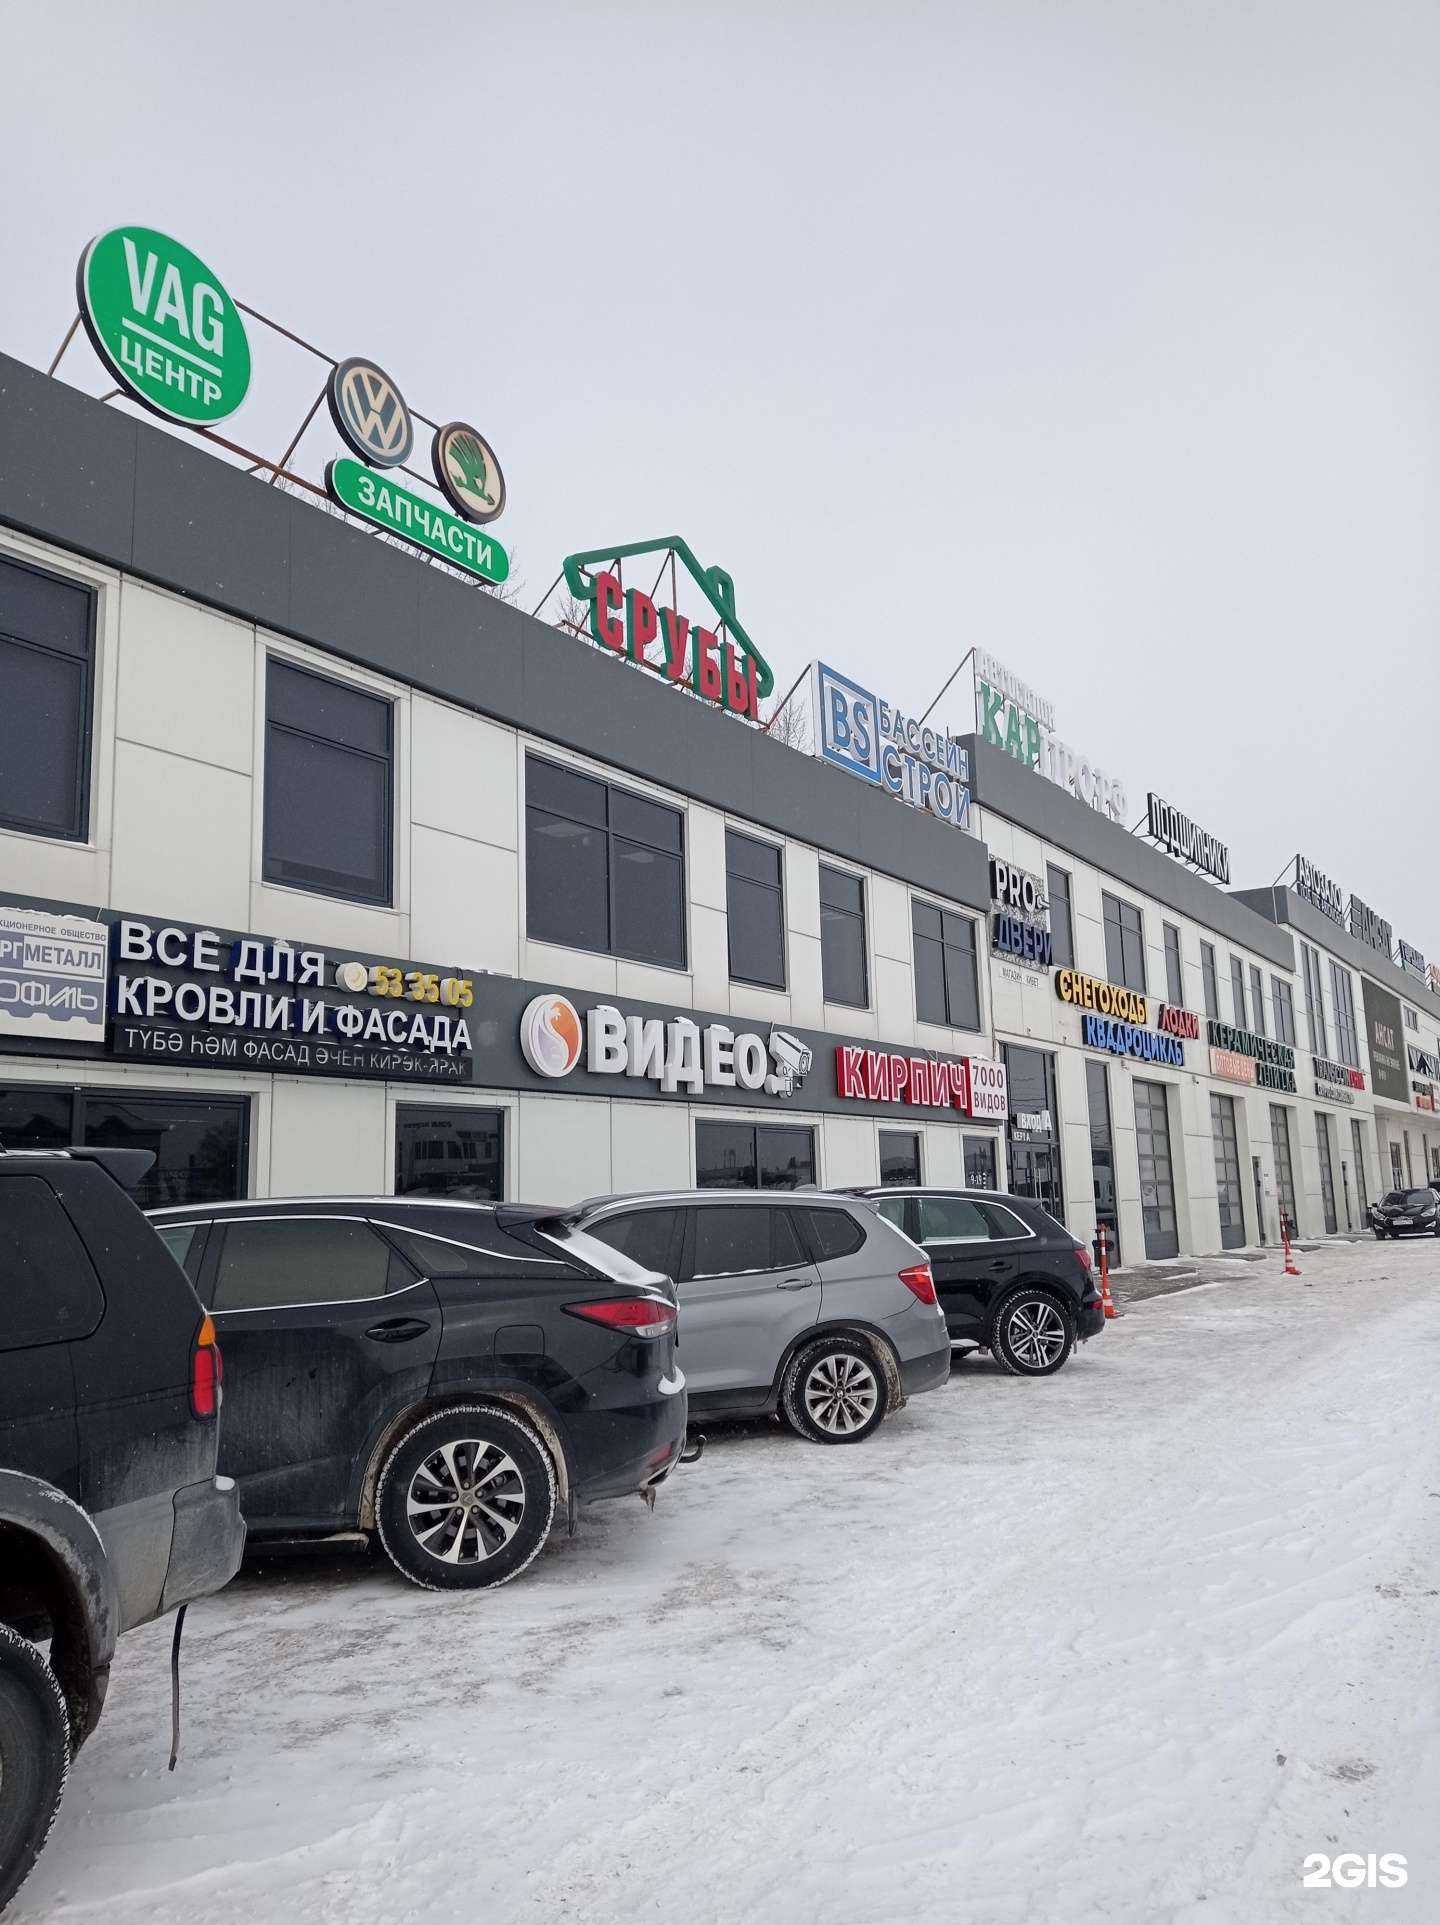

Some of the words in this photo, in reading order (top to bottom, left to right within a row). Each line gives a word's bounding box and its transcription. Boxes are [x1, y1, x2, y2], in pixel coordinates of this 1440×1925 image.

[122, 237, 225, 357] VAG
[120, 334, 223, 406] ЦЕНТР
[357, 475, 493, 570] ЗАПЧАСТИ
[594, 571, 759, 720] СРУБЫ
[830, 686, 871, 761] BS
[879, 700, 970, 784] БАССЕЙН
[881, 742, 972, 830] СТРОЙ
[993, 860, 1036, 913] PRO
[60, 928, 106, 942] ОБЩЕСТВО
[120, 920, 221, 972] ВСЕ
[234, 940, 325, 986] ДЛЯ
[995, 912, 1052, 965] ДВЕРИ
[117, 976, 290, 1031] КРОВЛИ
[302, 999, 325, 1034] И
[336, 1005, 473, 1053] ФАСАДА
[1058, 969, 1147, 1024] СНЕГОХОДЫ
[1159, 1004, 1200, 1039] ЛОДКИ
[244, 1040, 310, 1066] ФАСАД
[588, 1005, 768, 1094] ВИДЕО
[1083, 1015, 1184, 1066] КВАДРОЦИКЛЫ
[837, 1044, 967, 1109] КИРПИЧ
[972, 1064, 1005, 1090] 7000
[974, 1092, 1006, 1114] ВИДОВ
[1020, 1113, 1042, 1132] ВХОД
